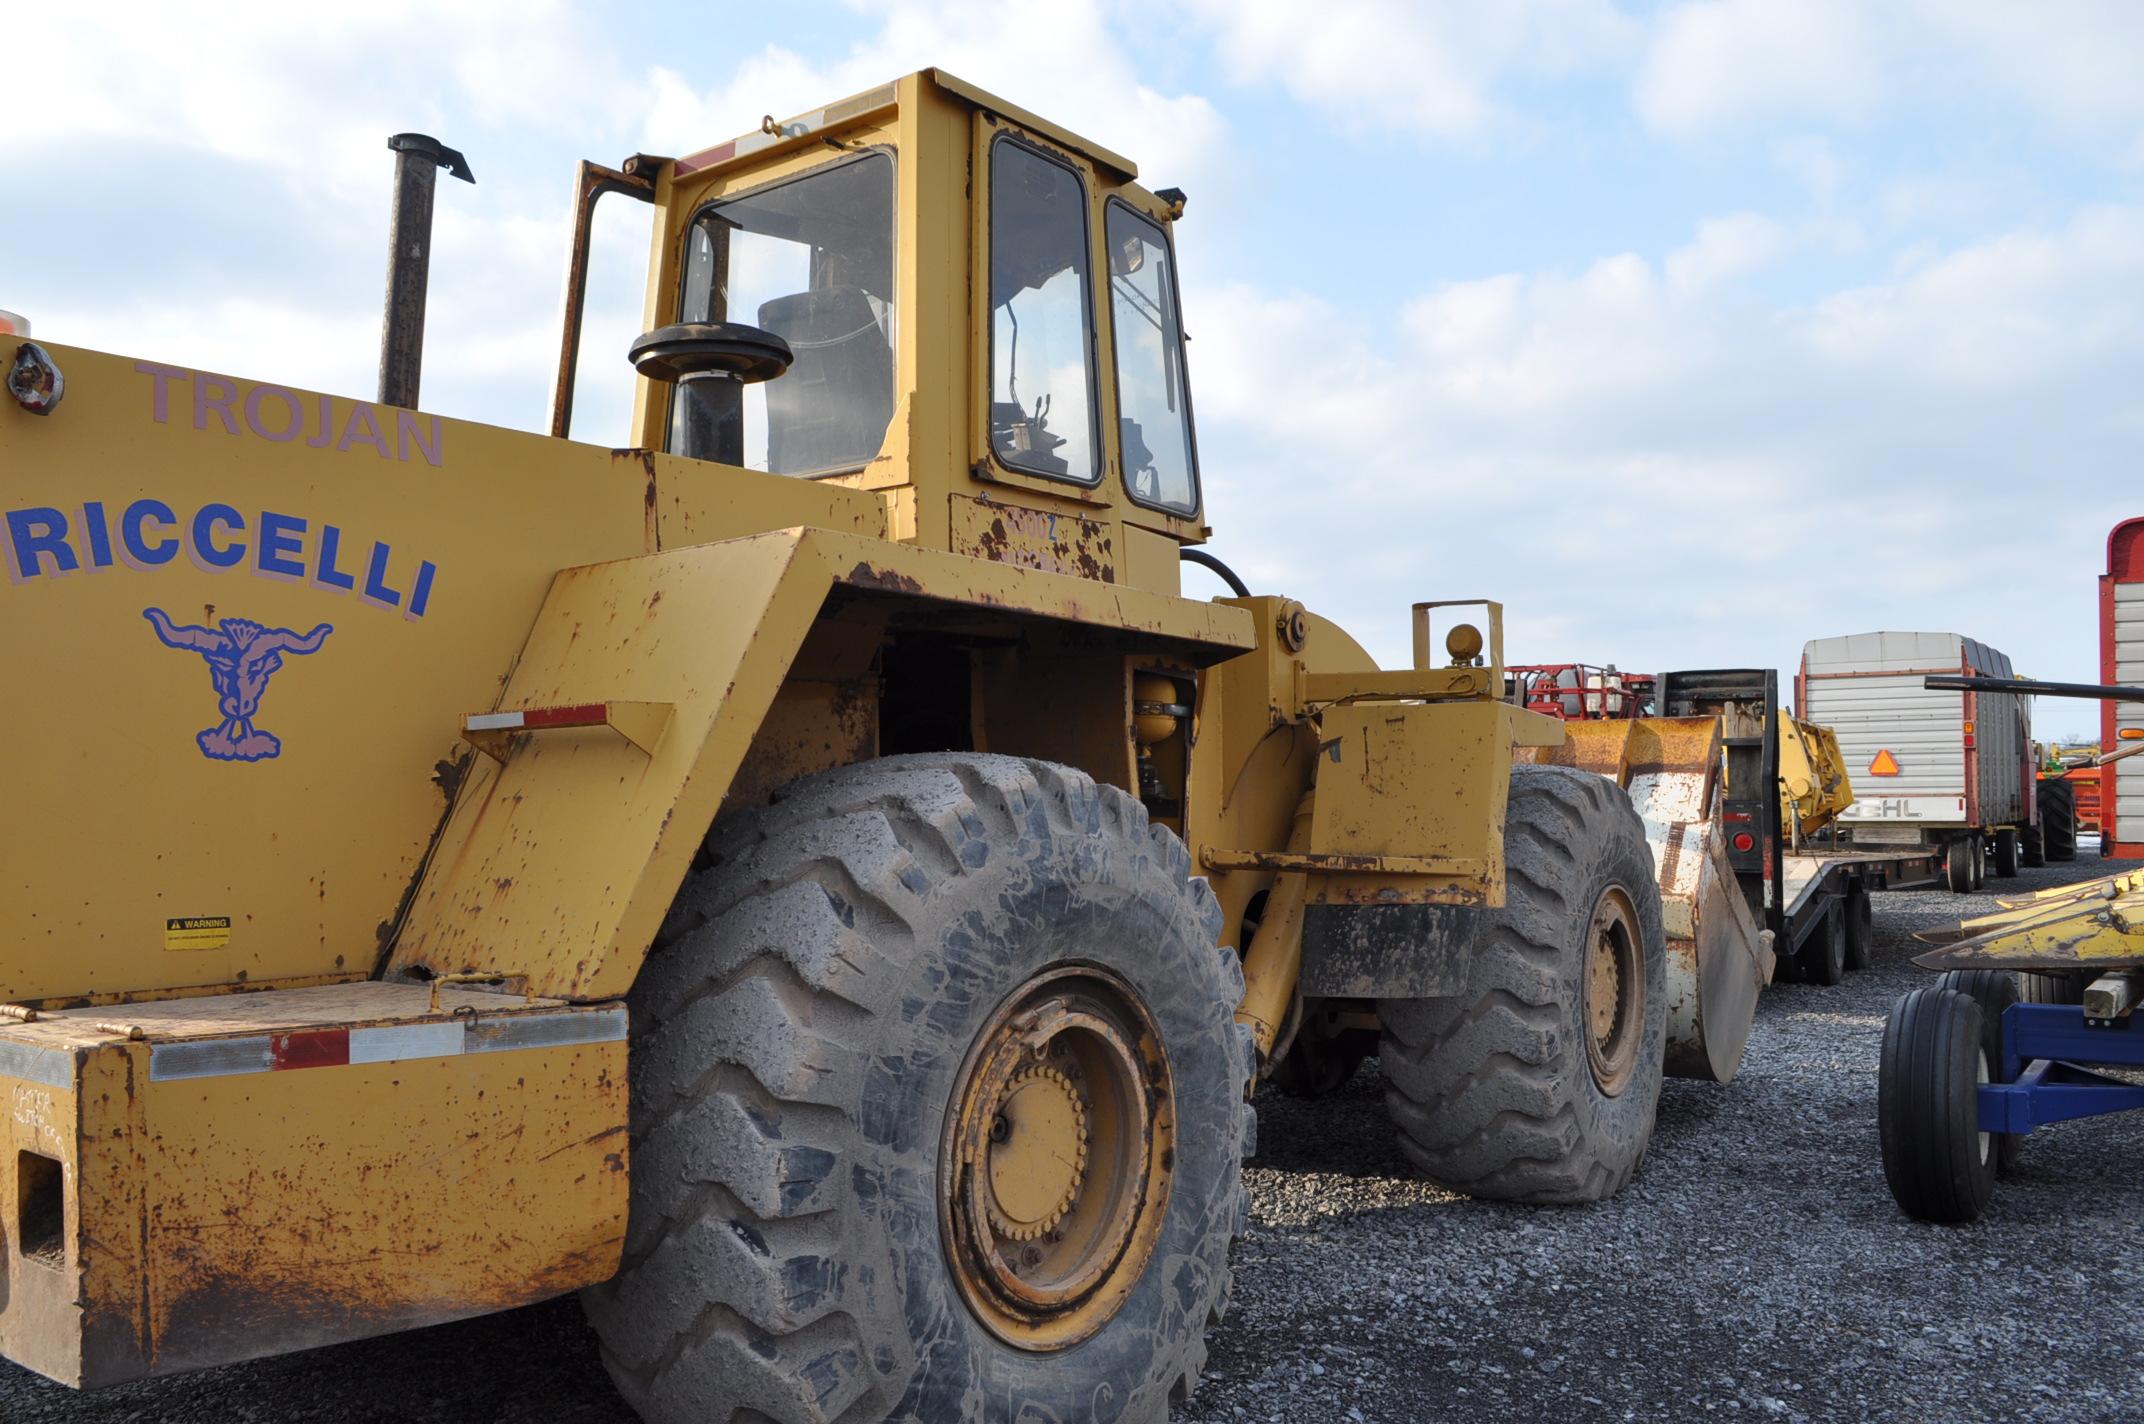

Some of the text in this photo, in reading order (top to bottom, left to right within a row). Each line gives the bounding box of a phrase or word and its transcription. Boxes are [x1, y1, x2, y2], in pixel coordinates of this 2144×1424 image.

[135, 362, 442, 467] TROJAN
[2, 499, 437, 621] RICCELLI
[184, 919, 227, 929] WARNING
